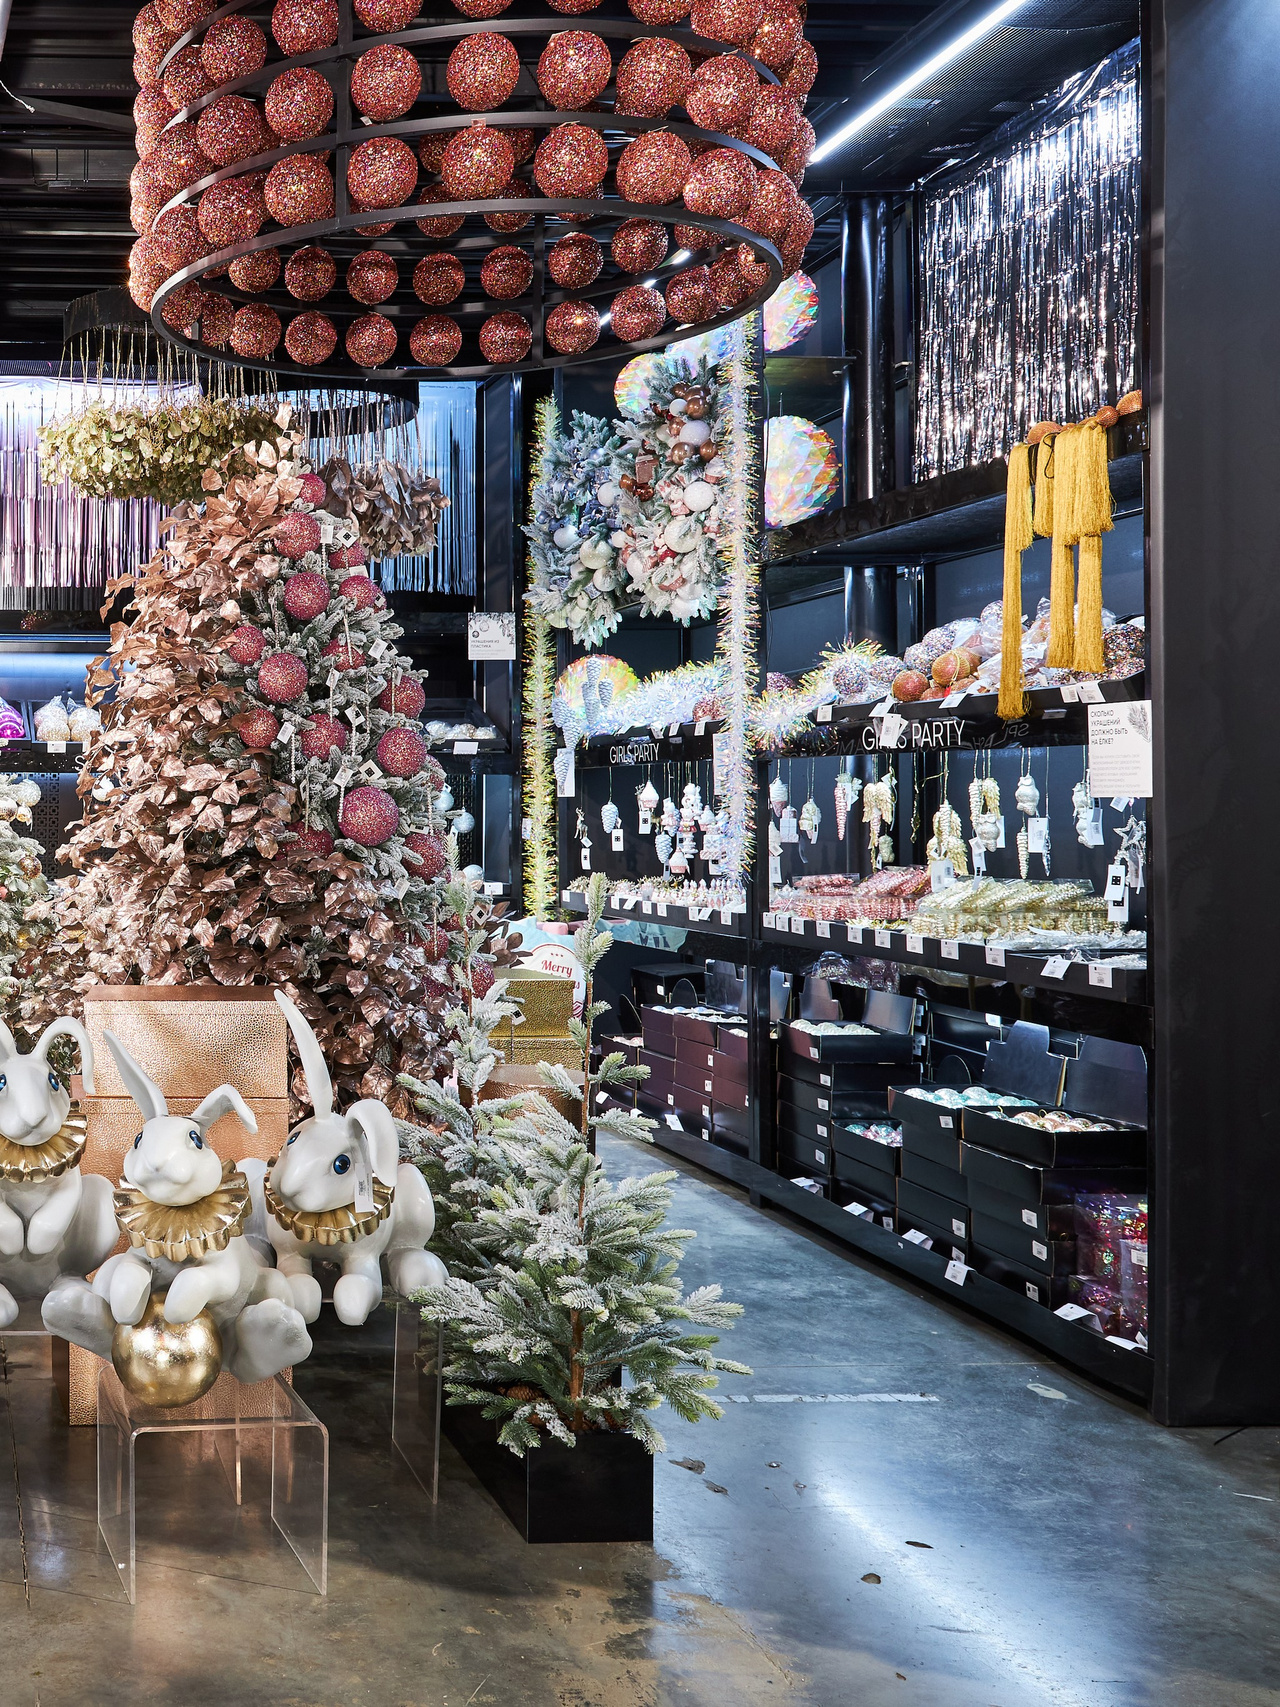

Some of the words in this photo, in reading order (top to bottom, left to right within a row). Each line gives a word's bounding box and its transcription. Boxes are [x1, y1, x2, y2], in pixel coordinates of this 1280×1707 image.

[1090, 710, 1114, 718] СКОЛЬКО
[1090, 718, 1121, 727] УКРАШЕНИЙ
[912, 720, 965, 748] PARTY
[1114, 727, 1128, 735] БЫТЬ
[610, 745, 632, 763] GIRLS
[633, 743, 660, 762] PARTY
[542, 960, 572, 978] Merry
